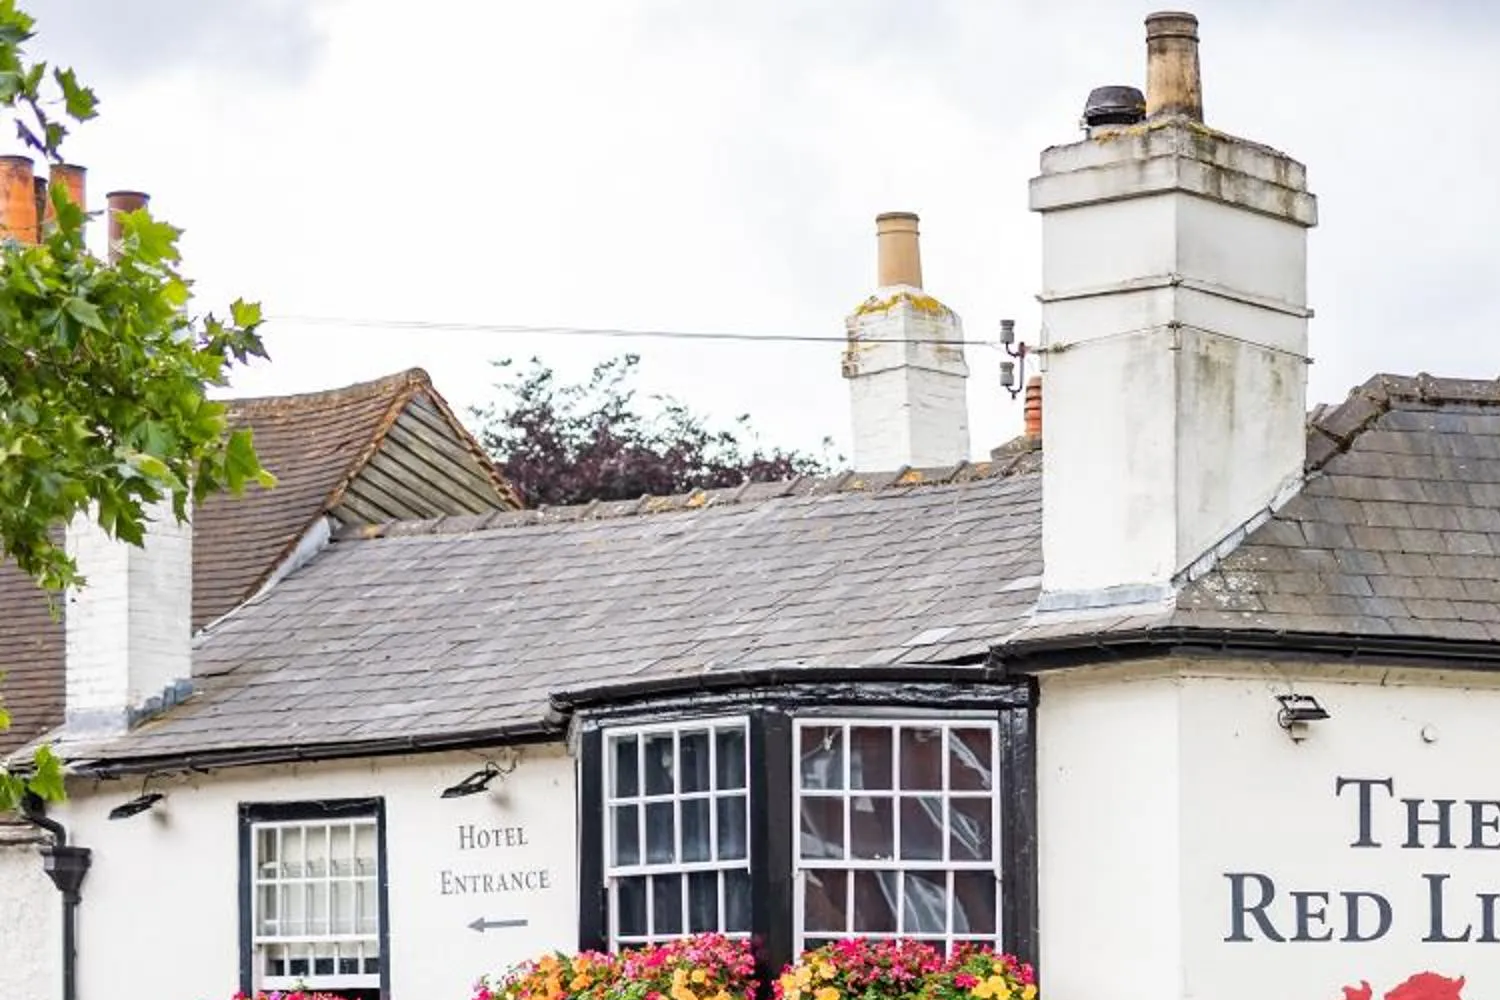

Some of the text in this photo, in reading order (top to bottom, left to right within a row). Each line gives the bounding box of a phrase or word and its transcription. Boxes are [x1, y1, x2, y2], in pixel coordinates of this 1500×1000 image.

[458, 824, 529, 849] HOTEL
[440, 869, 551, 895] ENTRANCE
[1222, 873, 1393, 943] RED
